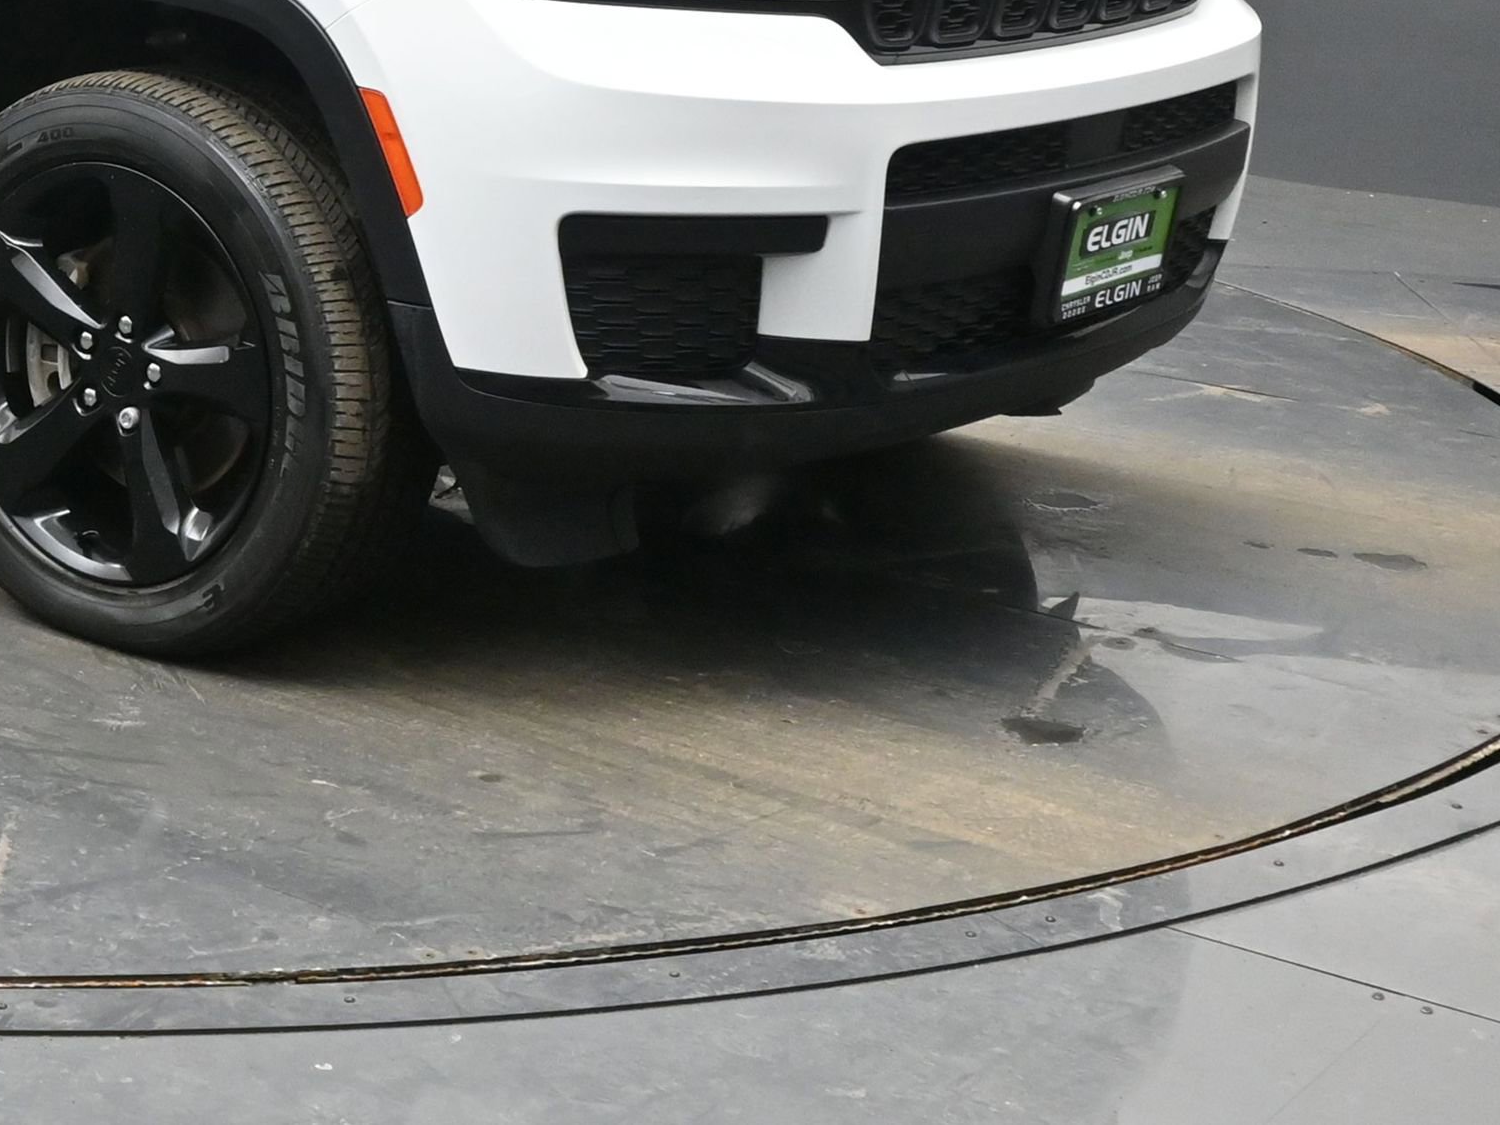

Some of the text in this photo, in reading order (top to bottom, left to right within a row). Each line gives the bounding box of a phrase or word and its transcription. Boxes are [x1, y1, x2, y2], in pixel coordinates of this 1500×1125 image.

[1086, 213, 1150, 252] ELGIN
[1061, 295, 1091, 312] CHRYSLER
[1094, 279, 1142, 308] ELGIN
